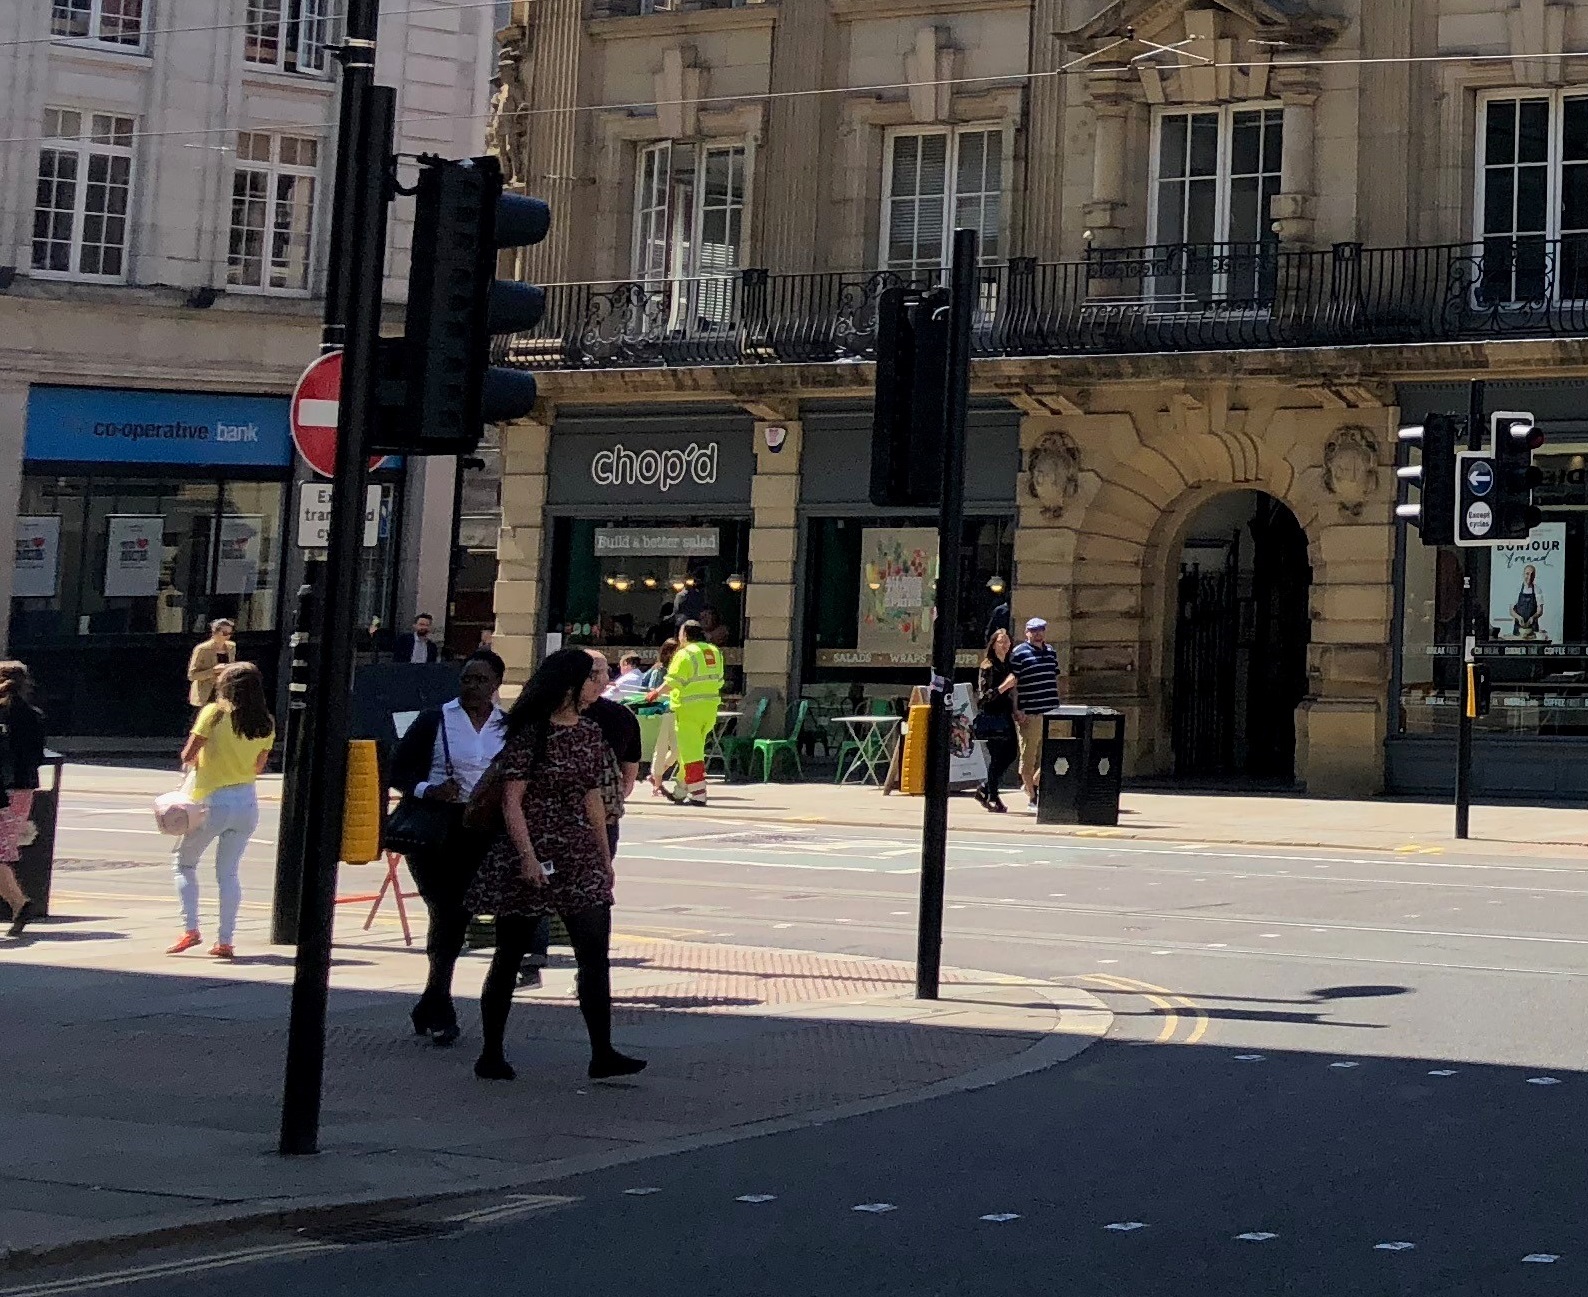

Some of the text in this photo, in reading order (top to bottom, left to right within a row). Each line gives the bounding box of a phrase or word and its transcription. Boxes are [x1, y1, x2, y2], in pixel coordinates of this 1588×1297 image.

[93, 421, 259, 442] co-operative bank
[592, 442, 718, 491] chop'd
[833, 653, 979, 664] SALADS WRAPS UPS
